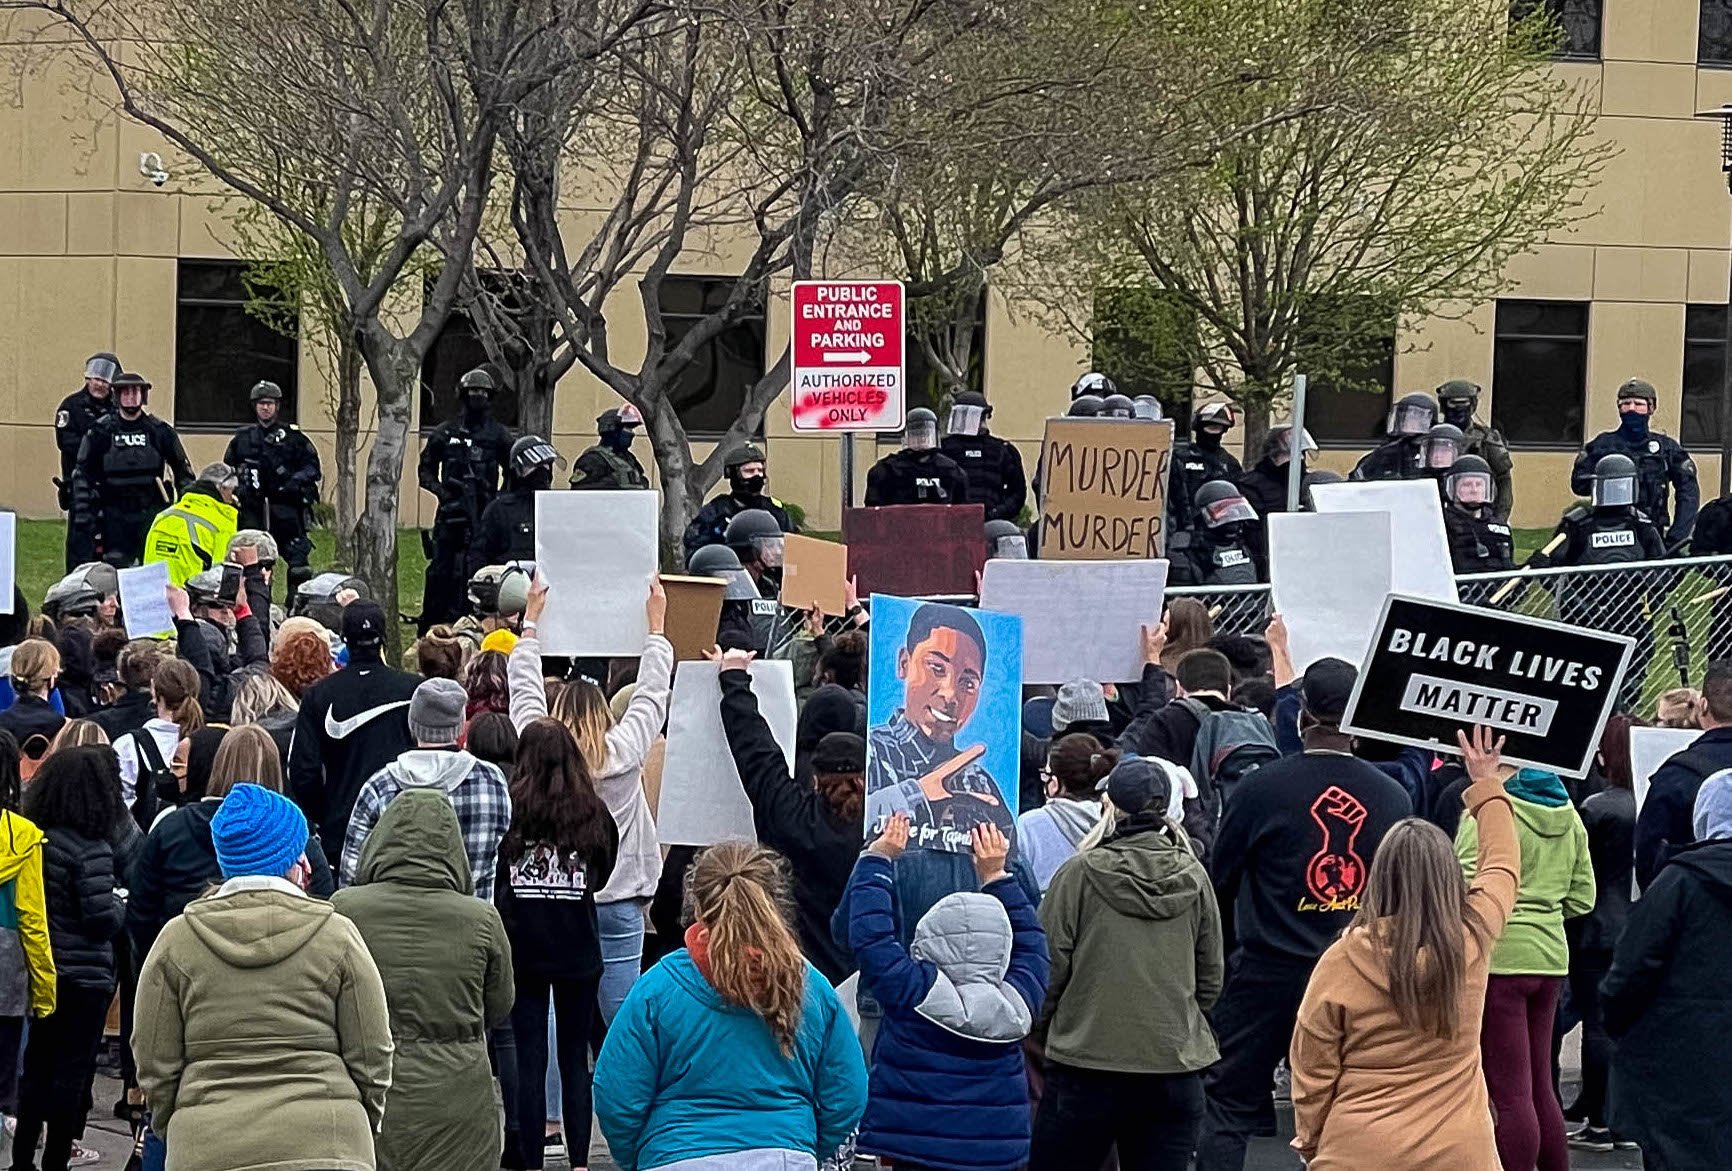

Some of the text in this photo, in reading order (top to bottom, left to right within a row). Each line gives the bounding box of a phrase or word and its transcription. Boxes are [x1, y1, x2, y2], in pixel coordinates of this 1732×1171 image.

[817, 286, 878, 302] PUBLIC
[802, 303, 893, 319] ENTRANCE
[833, 319, 862, 331] AND
[811, 332, 885, 348] PARKING
[800, 374, 896, 388] AUTHORIZED
[812, 390, 887, 405] VEHICLES
[828, 408, 868, 422] ONLY
[1046, 441, 1169, 501] MURDER
[1041, 511, 1162, 559] MURDER
[1595, 533, 1632, 544] POLICE
[1388, 628, 1602, 690] BLACK LIVES
[1414, 683, 1542, 727] MATTER
[918, 822, 939, 847] for
